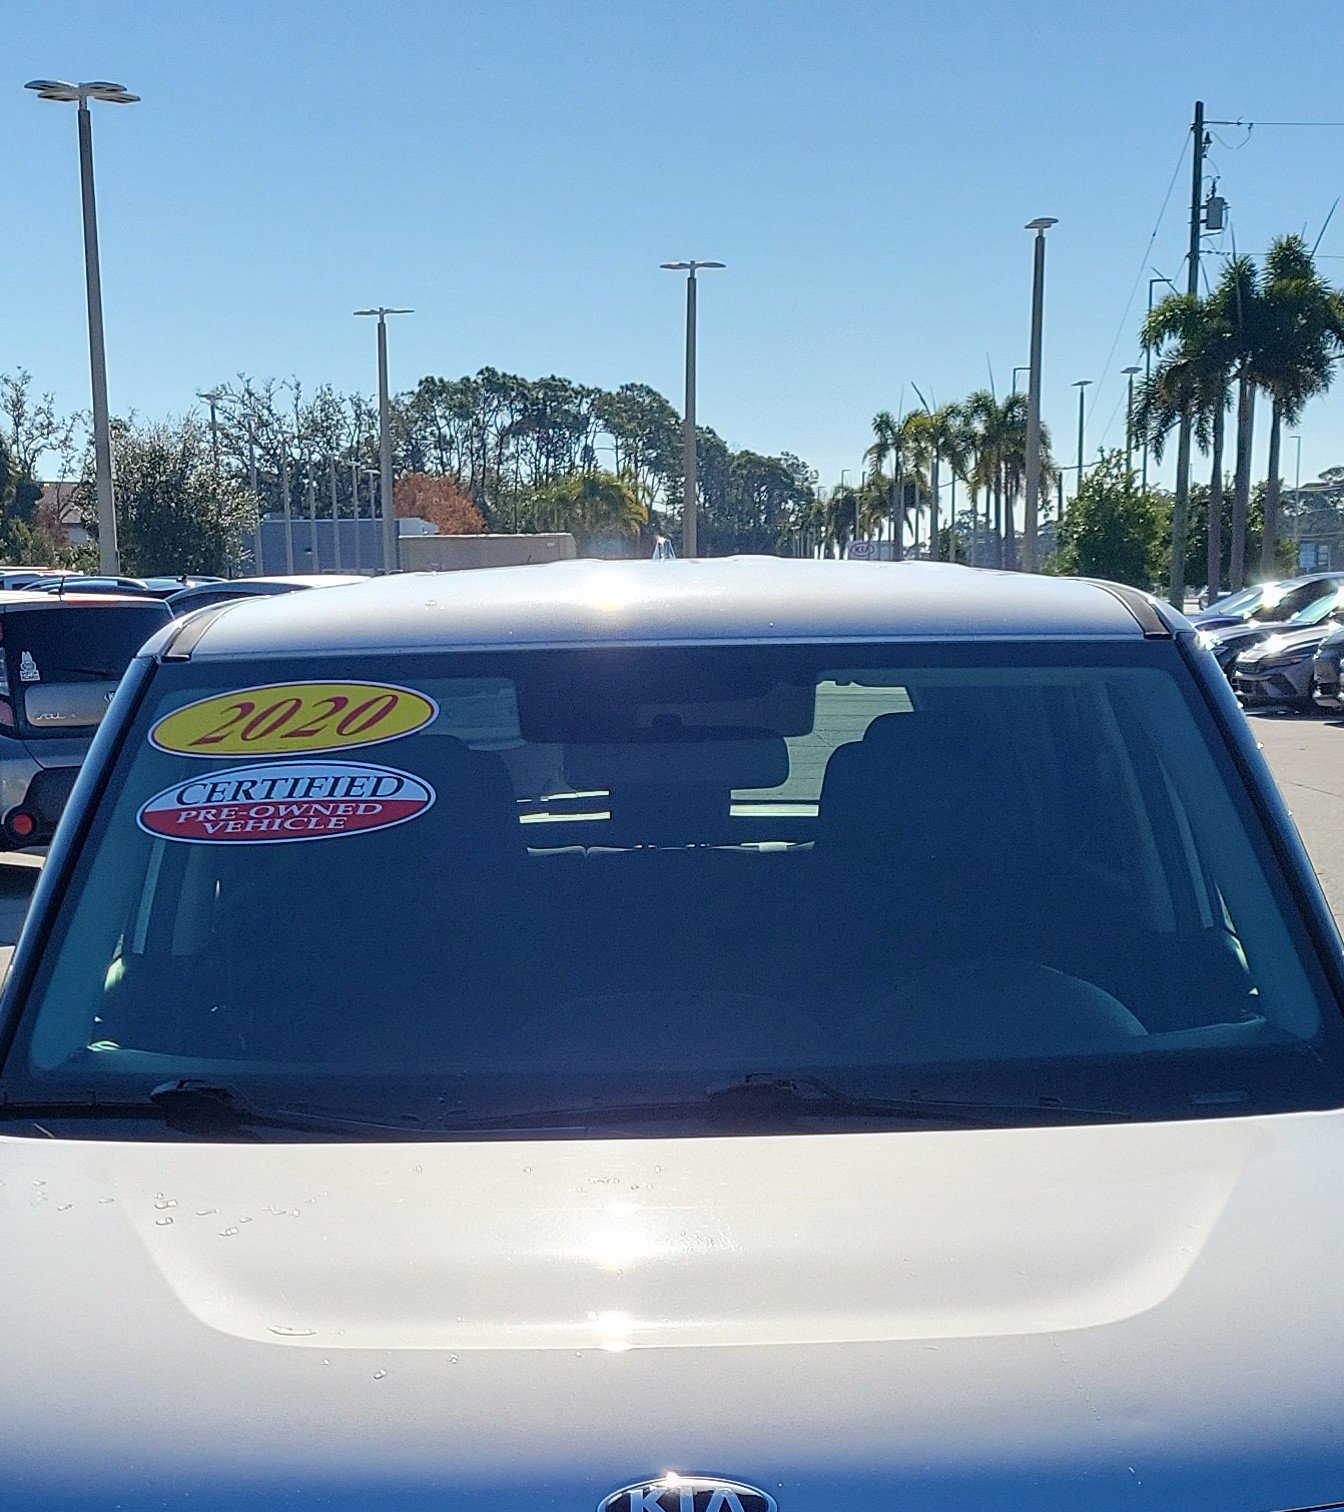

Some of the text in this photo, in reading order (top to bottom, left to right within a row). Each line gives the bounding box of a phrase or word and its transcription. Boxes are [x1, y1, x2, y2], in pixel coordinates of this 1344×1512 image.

[188, 694, 399, 746] 2020
[176, 776, 404, 805] CERTIFIED
[176, 802, 383, 824] PRE-OWNED
[203, 816, 348, 834] VEHICLE
